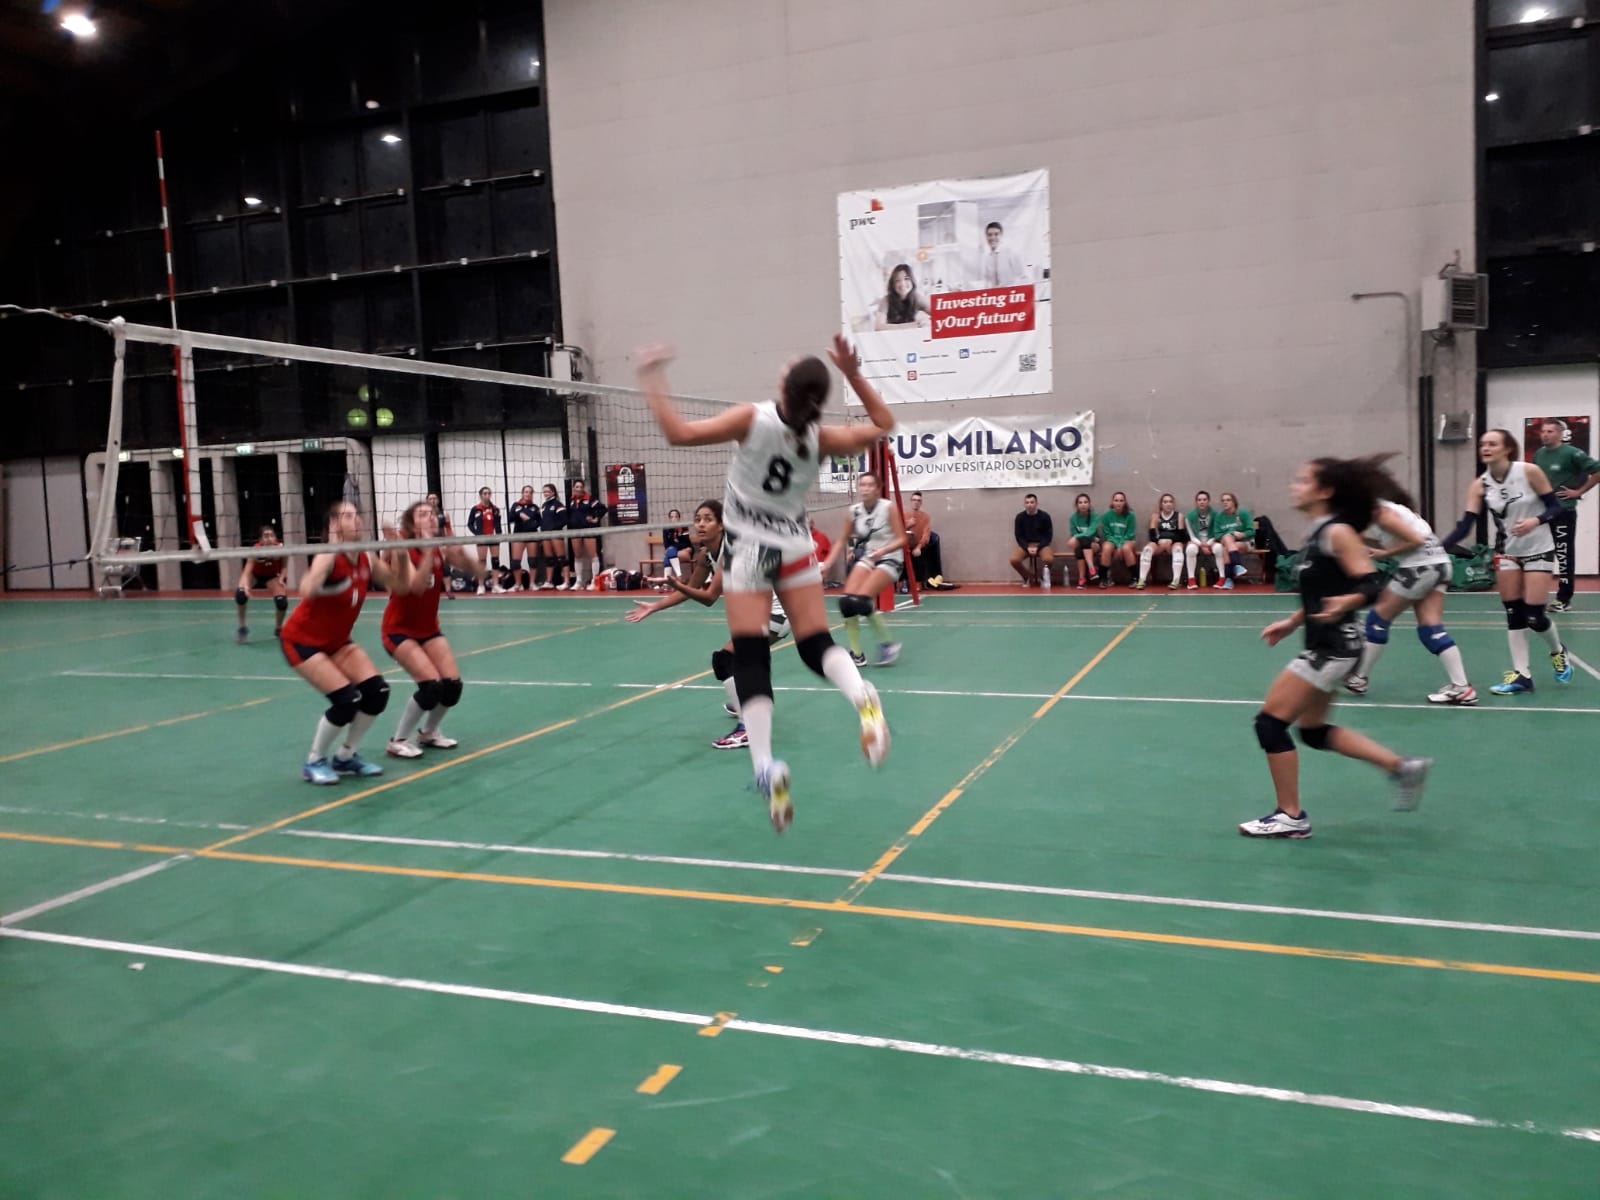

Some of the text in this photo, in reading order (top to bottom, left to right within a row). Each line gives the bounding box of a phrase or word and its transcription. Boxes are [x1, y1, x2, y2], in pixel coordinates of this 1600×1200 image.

[849, 216, 876, 230] pwc
[935, 290, 1025, 312] Investing in
[935, 310, 1027, 332] yOur future
[888, 426, 1082, 459] US MILANO
[763, 457, 794, 493] 8
[926, 460, 1016, 474] UNIVERSITARIO
[1017, 456, 1082, 471] SPORTIVO
[1556, 525, 1568, 538] LA
